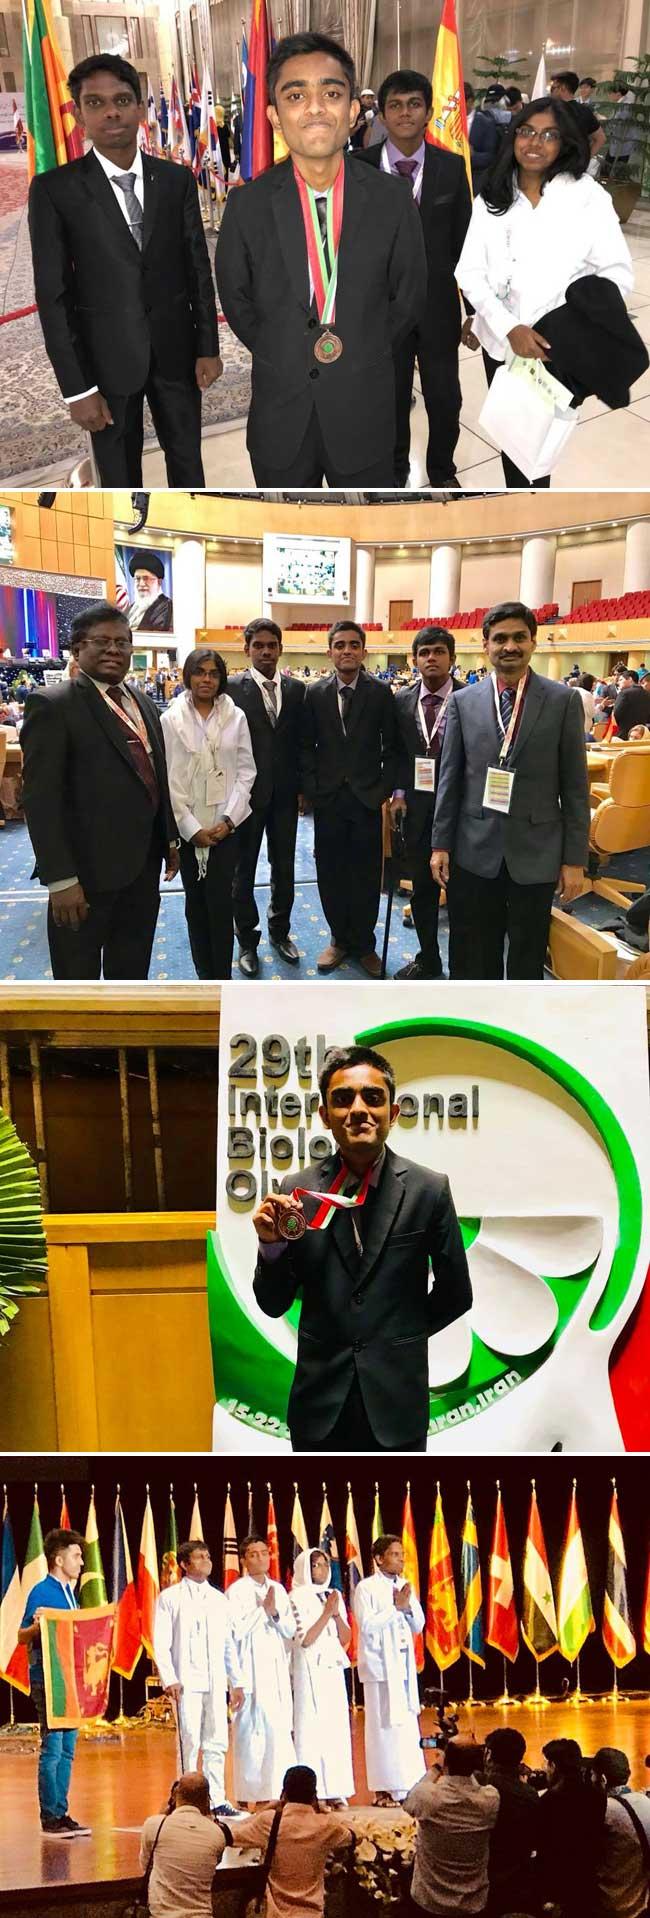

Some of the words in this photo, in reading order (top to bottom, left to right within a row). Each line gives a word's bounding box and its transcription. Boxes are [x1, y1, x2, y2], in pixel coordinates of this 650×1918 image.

[229, 1033, 340, 1078] 29th
[228, 1084, 479, 1118] Interonal
[227, 1127, 334, 1159] Biolo
